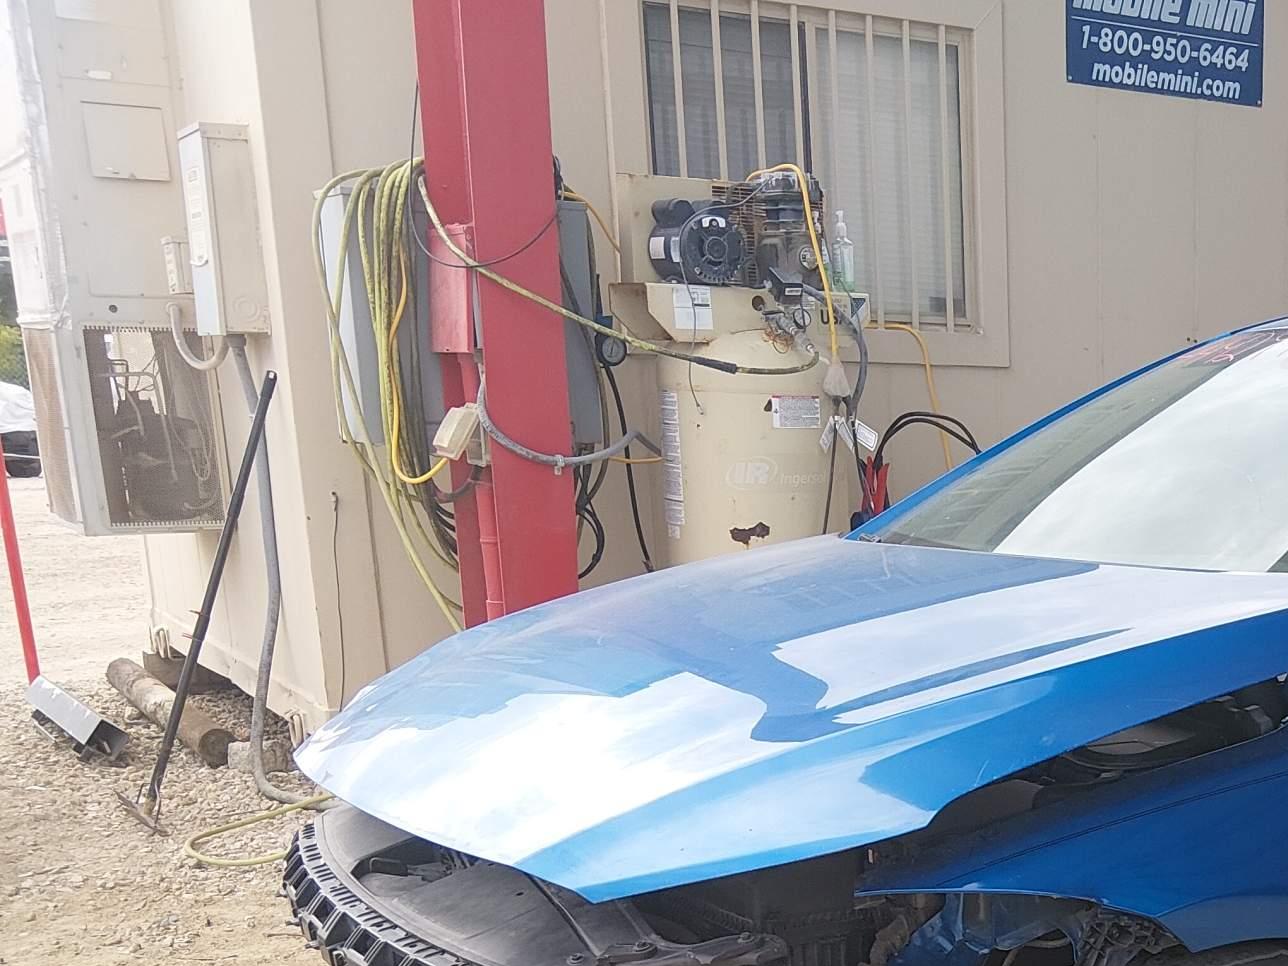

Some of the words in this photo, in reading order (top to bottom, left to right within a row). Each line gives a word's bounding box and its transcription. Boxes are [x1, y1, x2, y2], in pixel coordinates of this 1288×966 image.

[1186, 0, 1256, 35] mini
[1081, 25, 1249, 72] 1-800-950-6464
[1091, 62, 1241, 100] mobilemini.com
